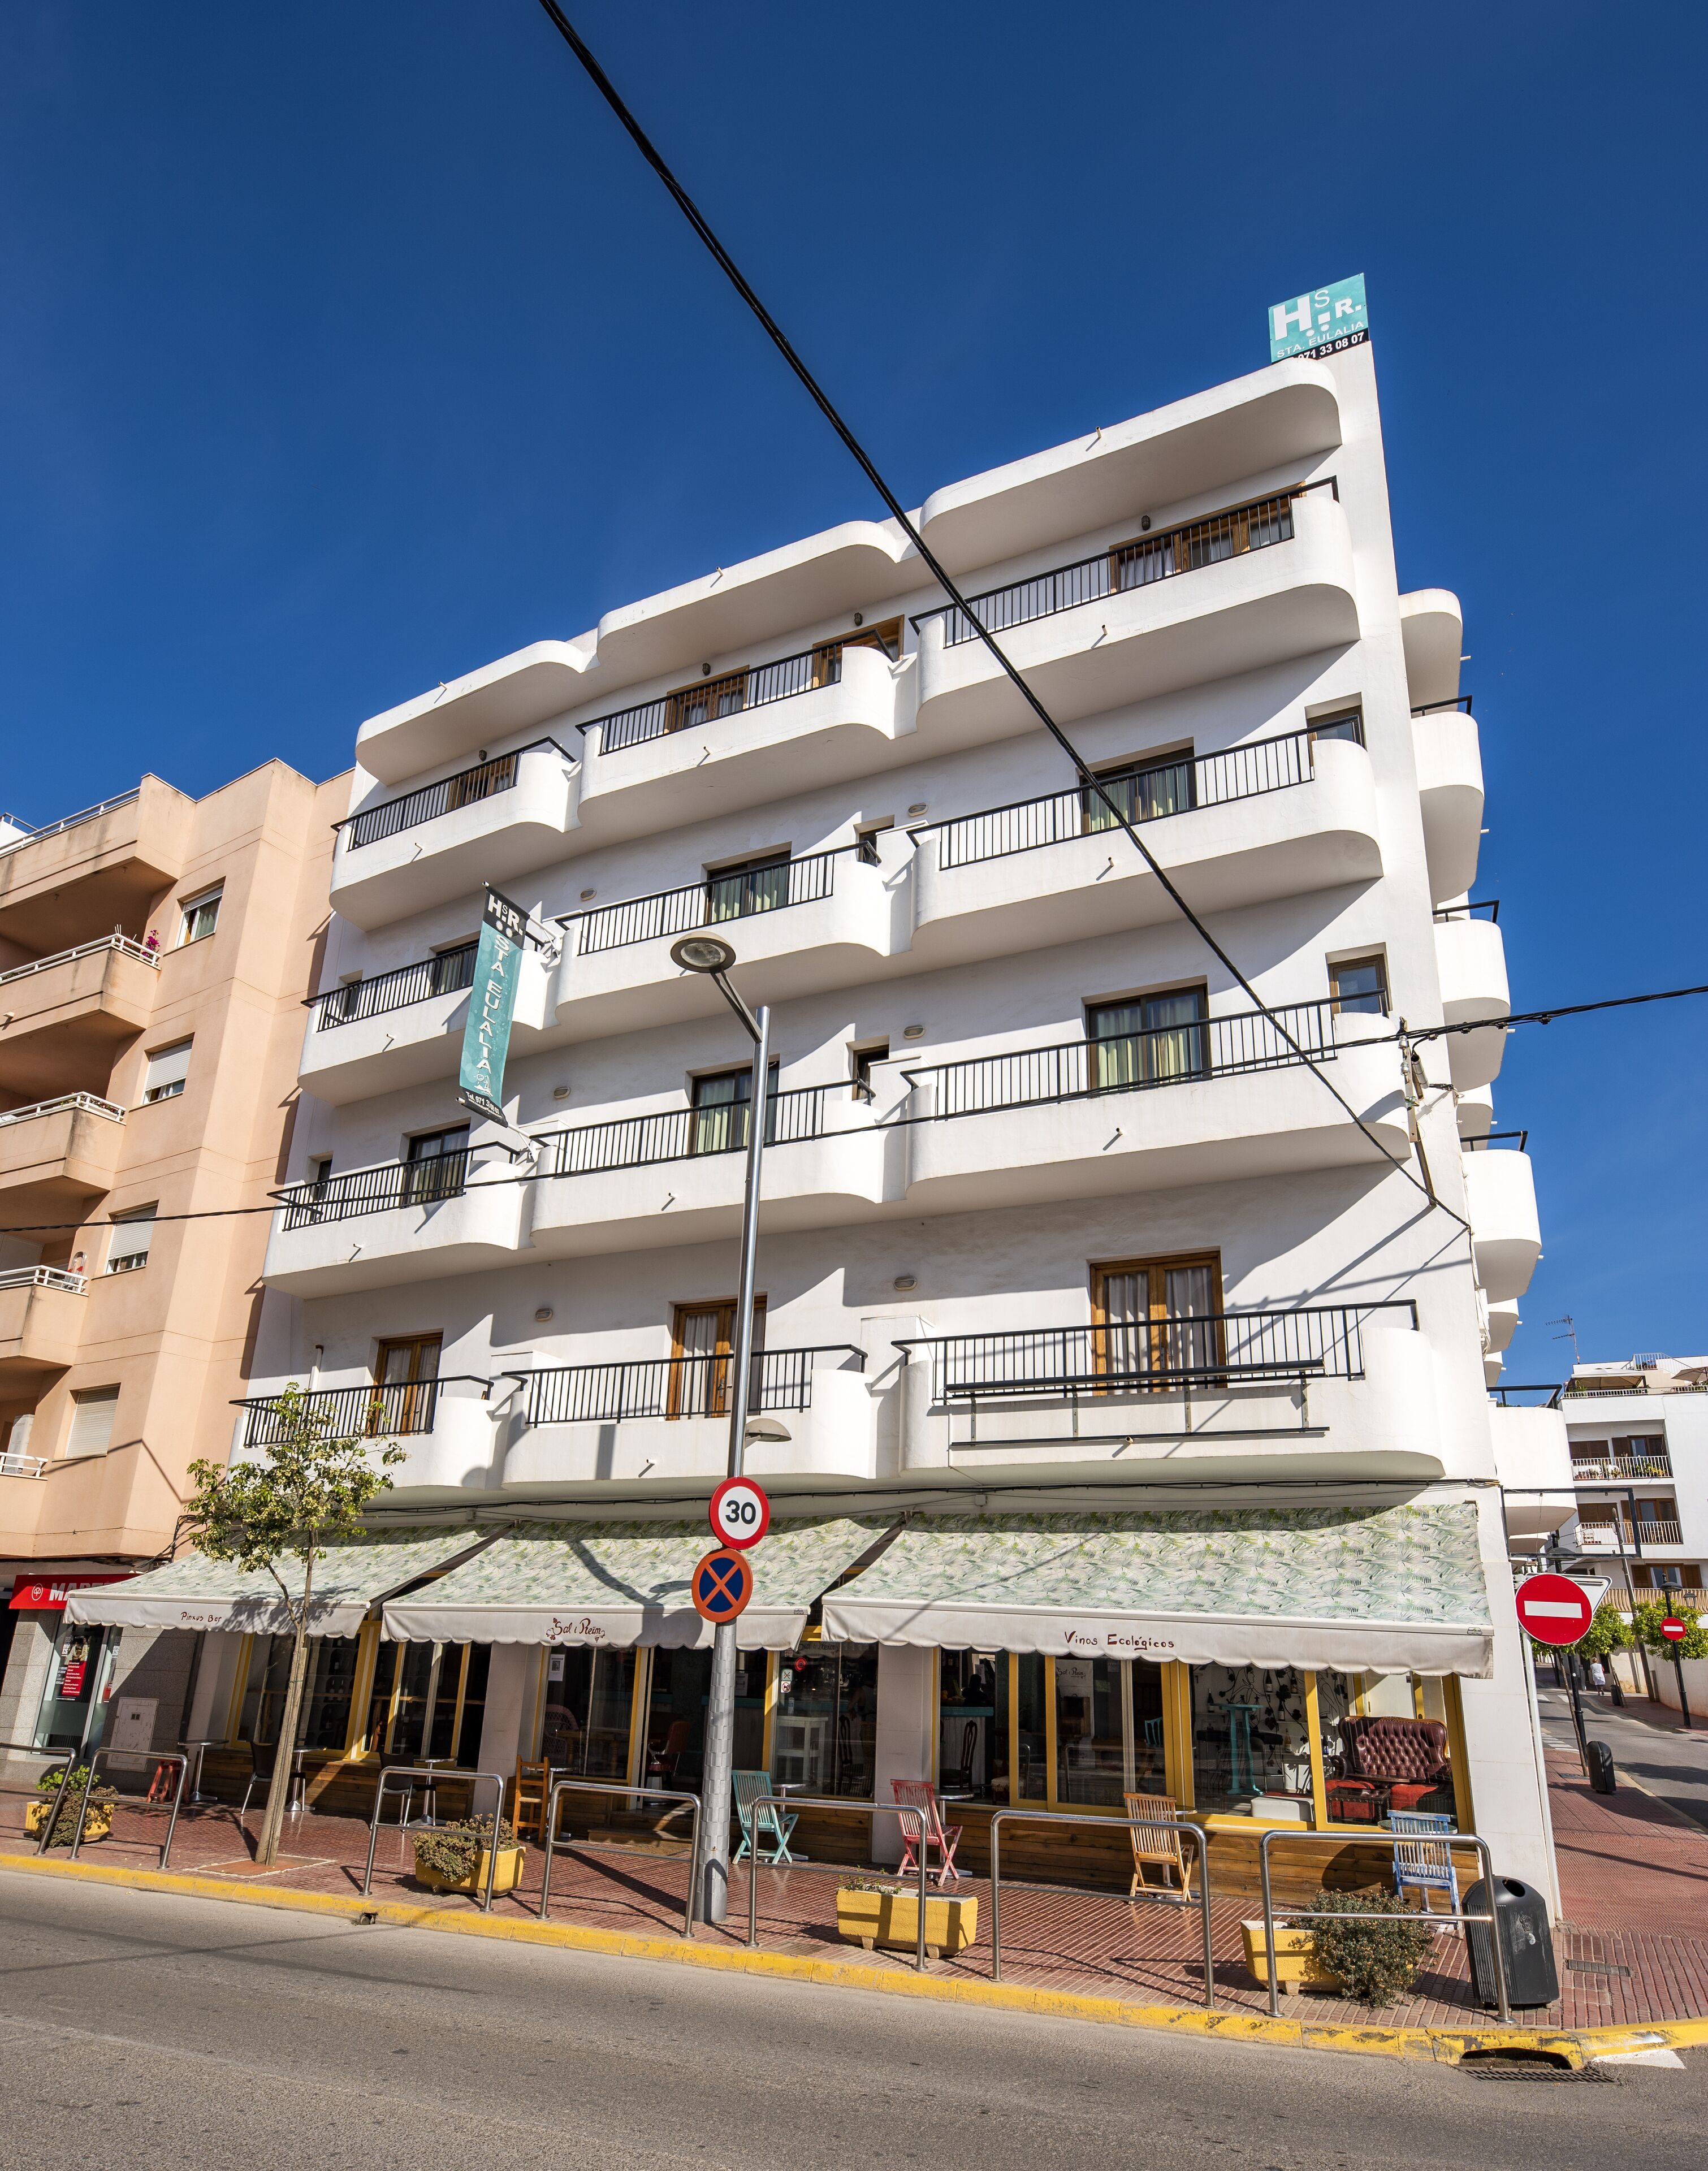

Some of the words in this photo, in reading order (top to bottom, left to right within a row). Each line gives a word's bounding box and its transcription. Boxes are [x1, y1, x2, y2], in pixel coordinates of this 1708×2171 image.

[1277, 344, 1305, 358] STA.
[1309, 321, 1364, 346] EULALIA
[1319, 343, 1333, 356] 33
[1335, 338, 1349, 349] 08
[1351, 331, 1364, 344] 07
[491, 934, 509, 978] STA
[476, 979, 503, 1074] EULALIA
[475, 1096, 485, 1105] 971
[725, 1500, 756, 1525] 30
[180, 1611, 204, 1621] Pinxus
[551, 1621, 573, 1636] Sal
[1065, 1631, 1098, 1645] Vinos
[1107, 1634, 1174, 1650] Ecológicos
